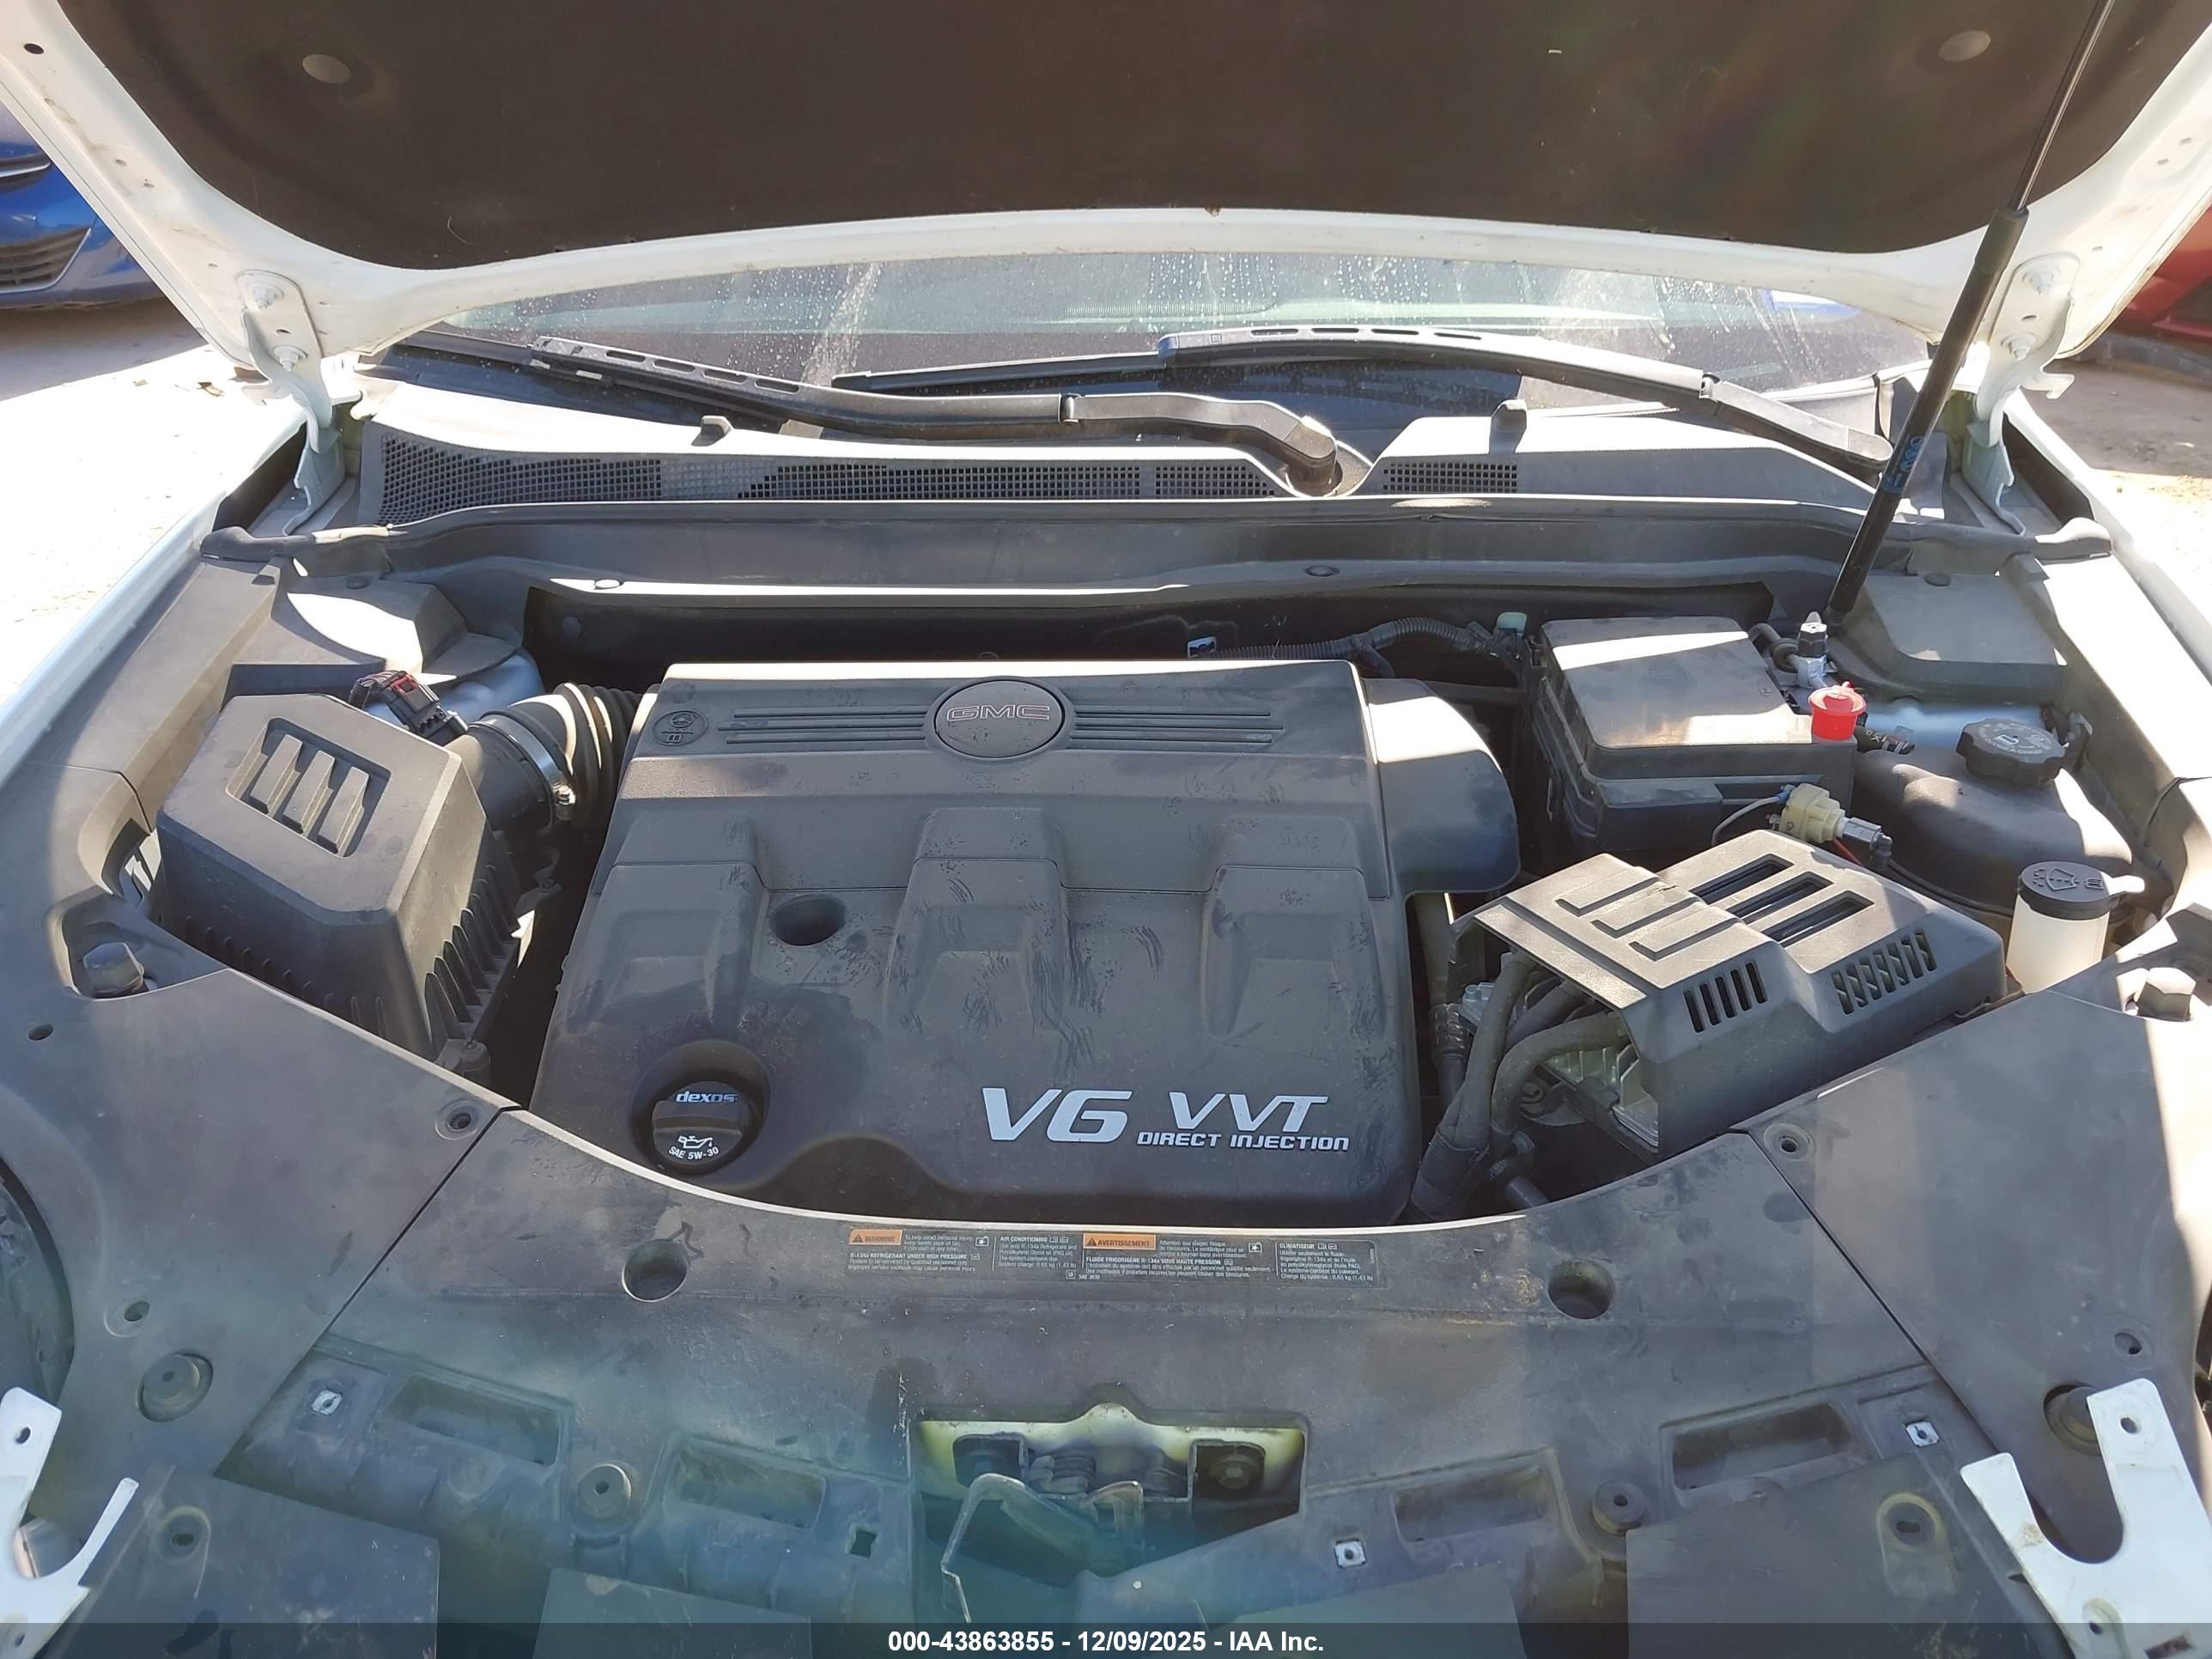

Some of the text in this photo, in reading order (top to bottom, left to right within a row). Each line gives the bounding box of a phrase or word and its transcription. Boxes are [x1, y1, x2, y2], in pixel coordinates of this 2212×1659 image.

[946, 704, 1050, 721] GMC
[675, 1091, 736, 1103] dexos
[981, 1086, 1329, 1144] V6 VVT
[1136, 1131, 1350, 1152] DIRECT INJECTION
[668, 1146, 720, 1161] SAE 5W-30
